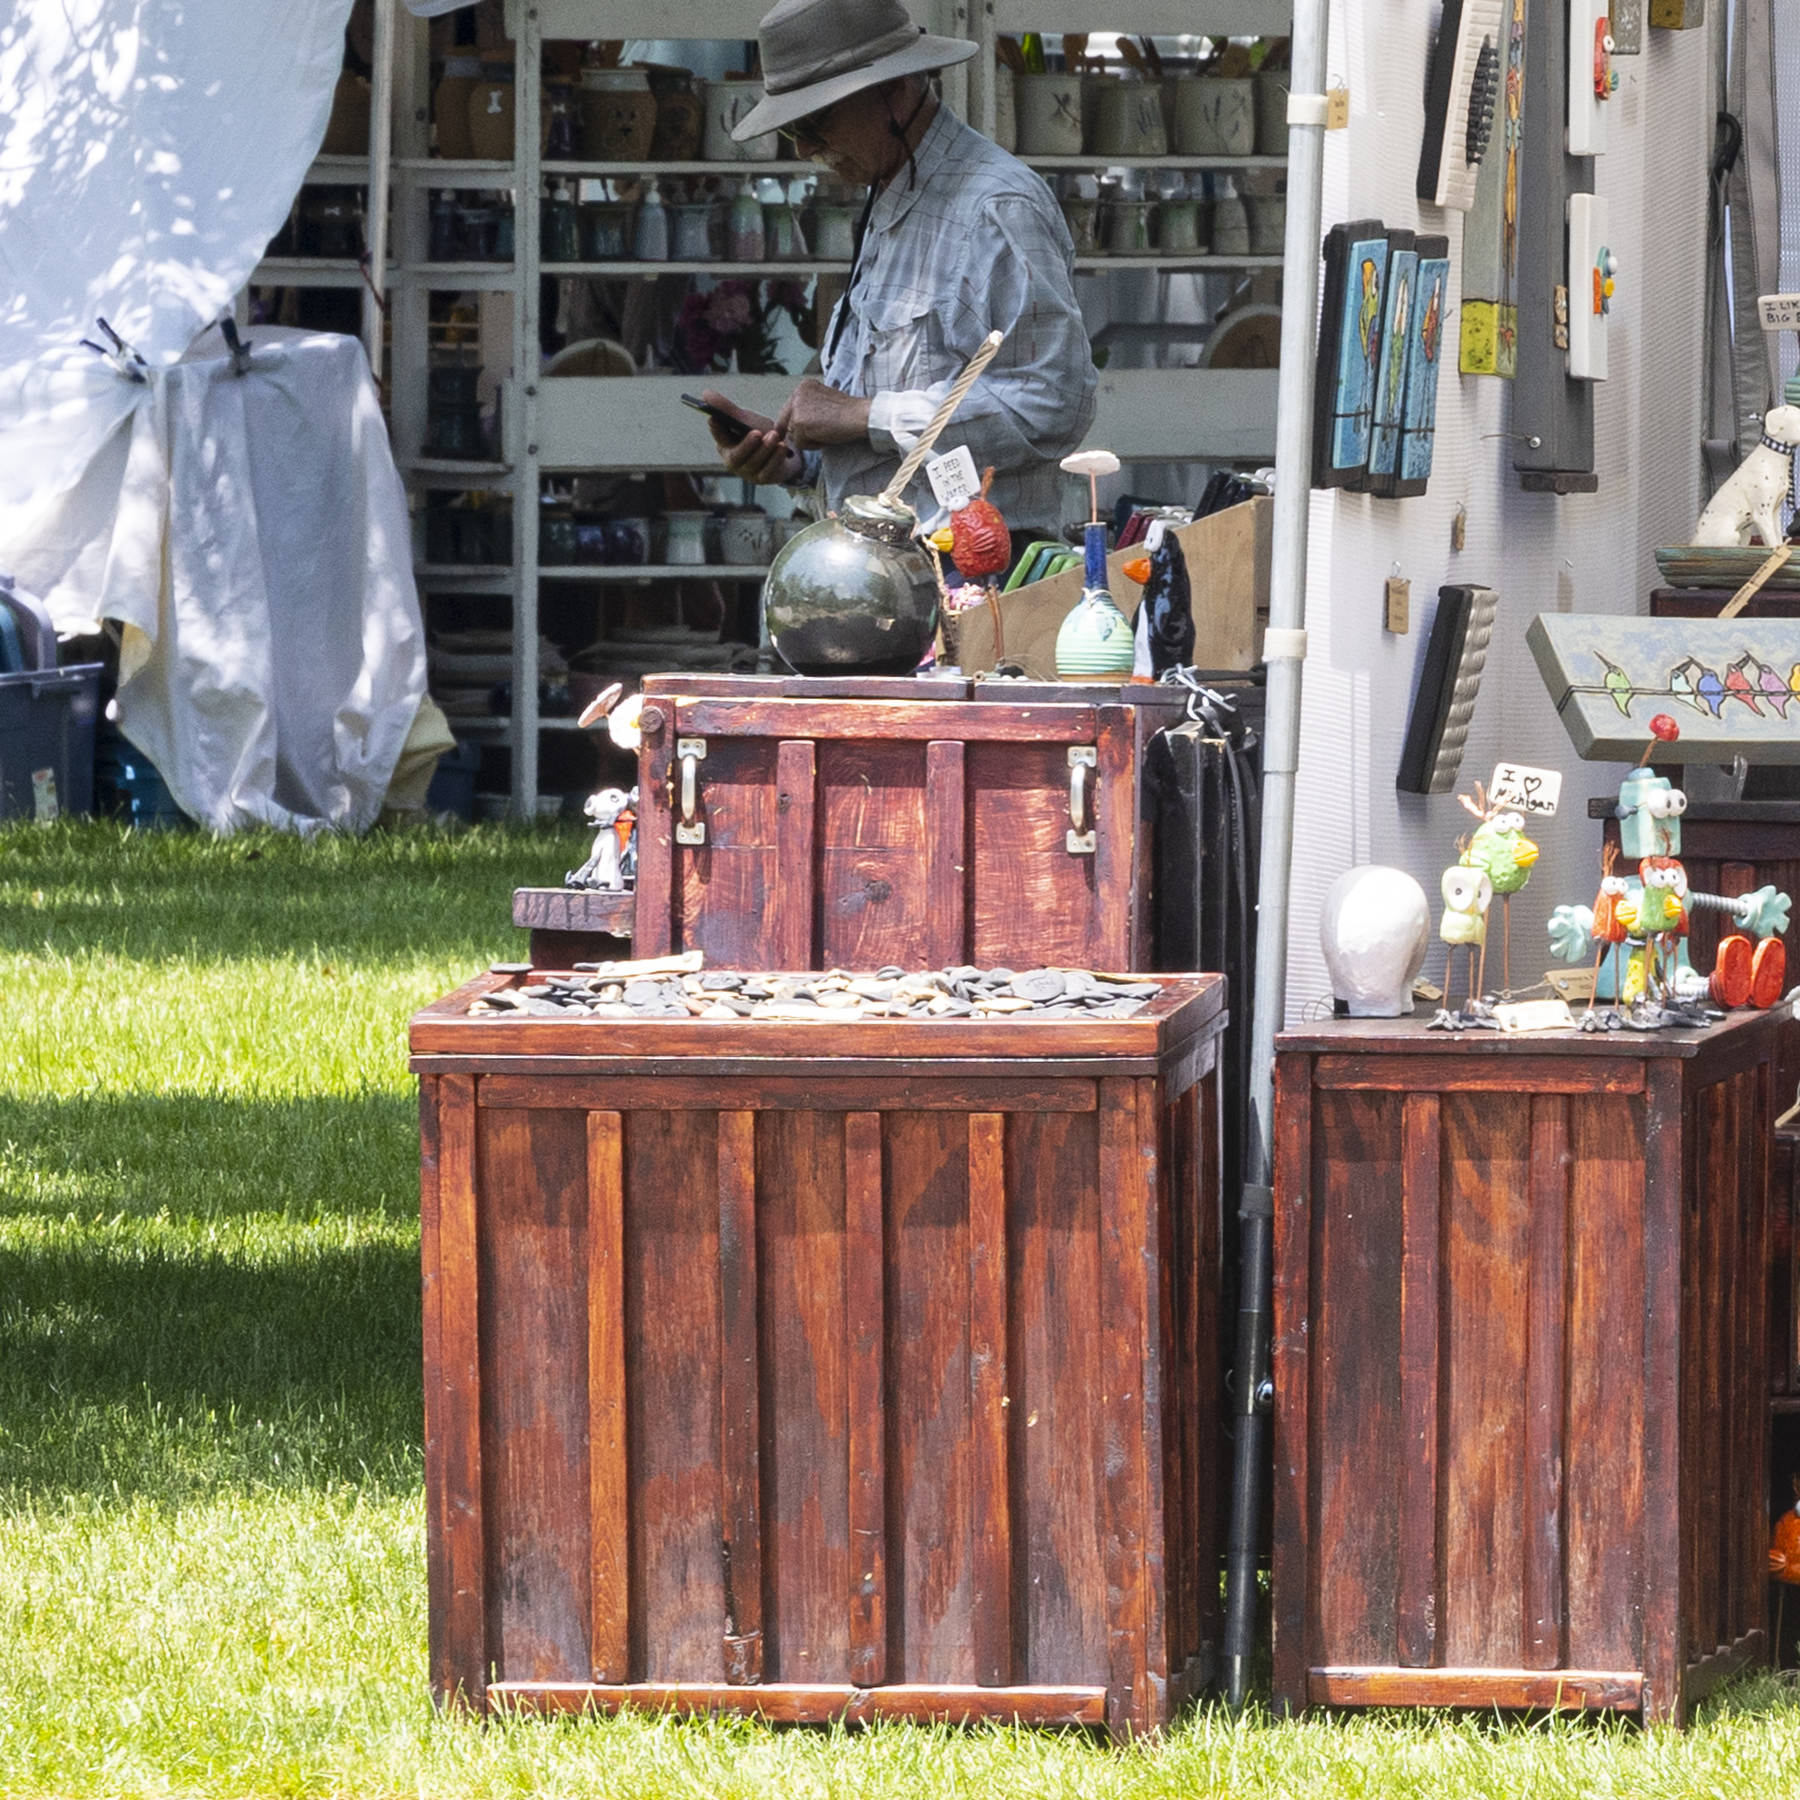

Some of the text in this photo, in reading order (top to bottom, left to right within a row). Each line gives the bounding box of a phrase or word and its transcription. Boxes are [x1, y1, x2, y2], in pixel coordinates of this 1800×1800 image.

[1764, 301, 1776, 312] I
[1766, 312, 1791, 324] BIG
[1502, 769, 1516, 783] I
[1494, 787, 1555, 811] Mchigan
